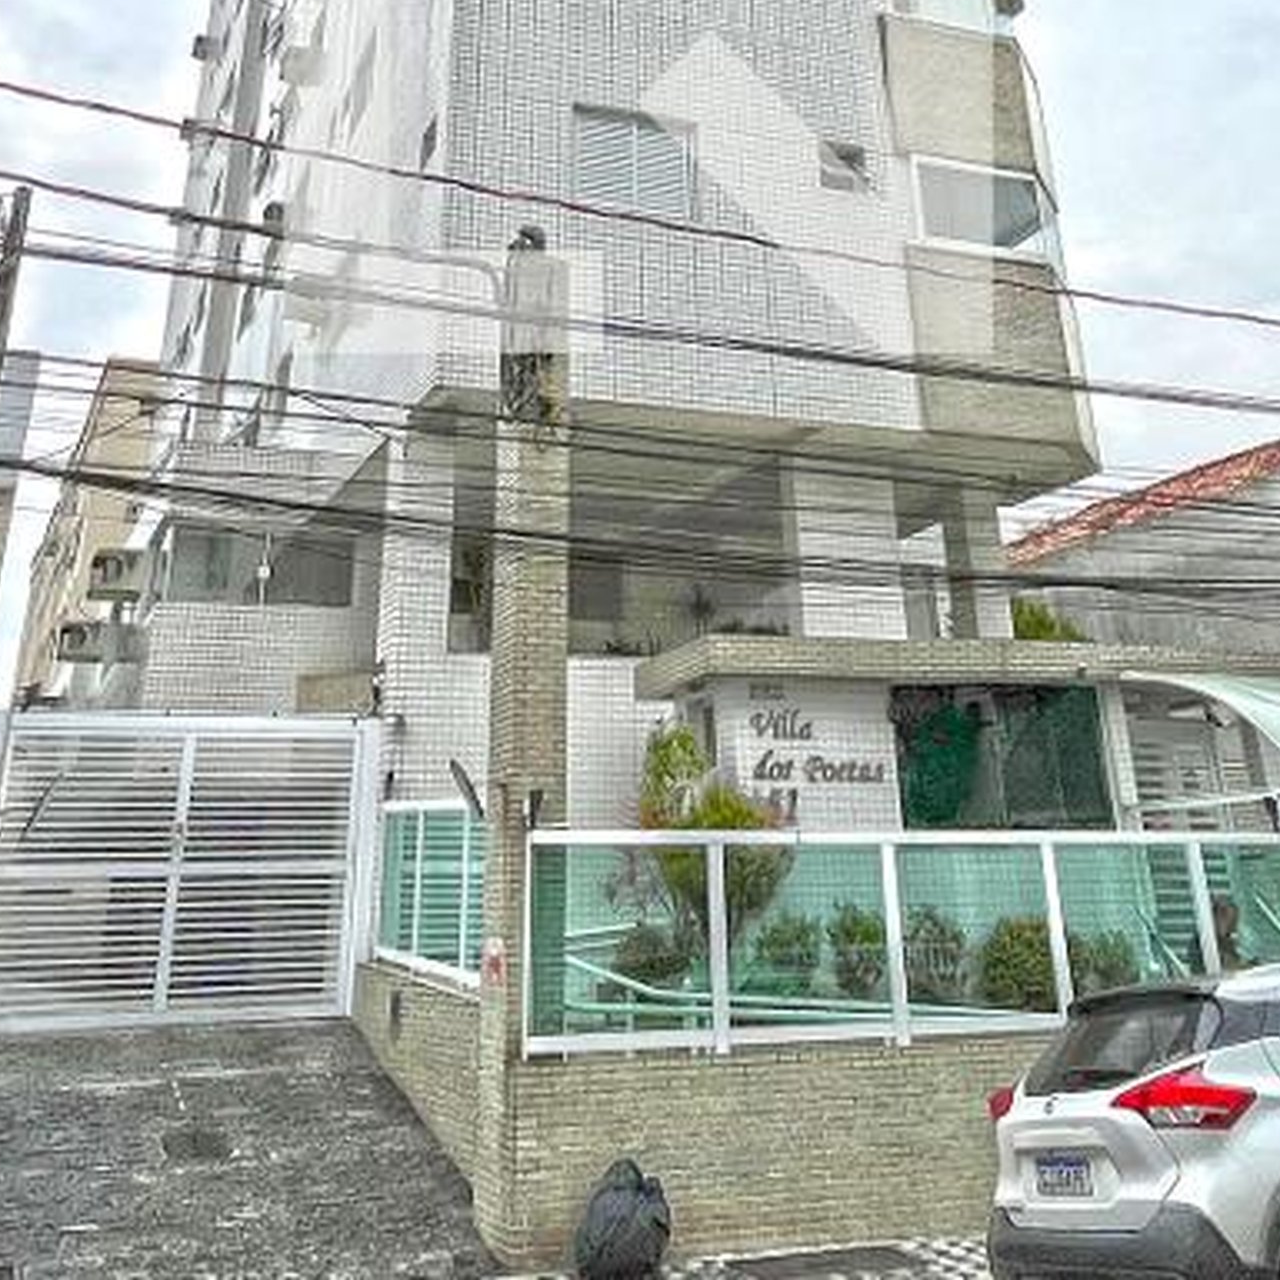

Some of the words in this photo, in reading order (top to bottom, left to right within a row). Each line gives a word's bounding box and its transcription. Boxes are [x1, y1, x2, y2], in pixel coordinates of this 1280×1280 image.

[749, 708, 813, 741] Villa
[753, 749, 794, 781] dos
[803, 756, 886, 783] Poetas
